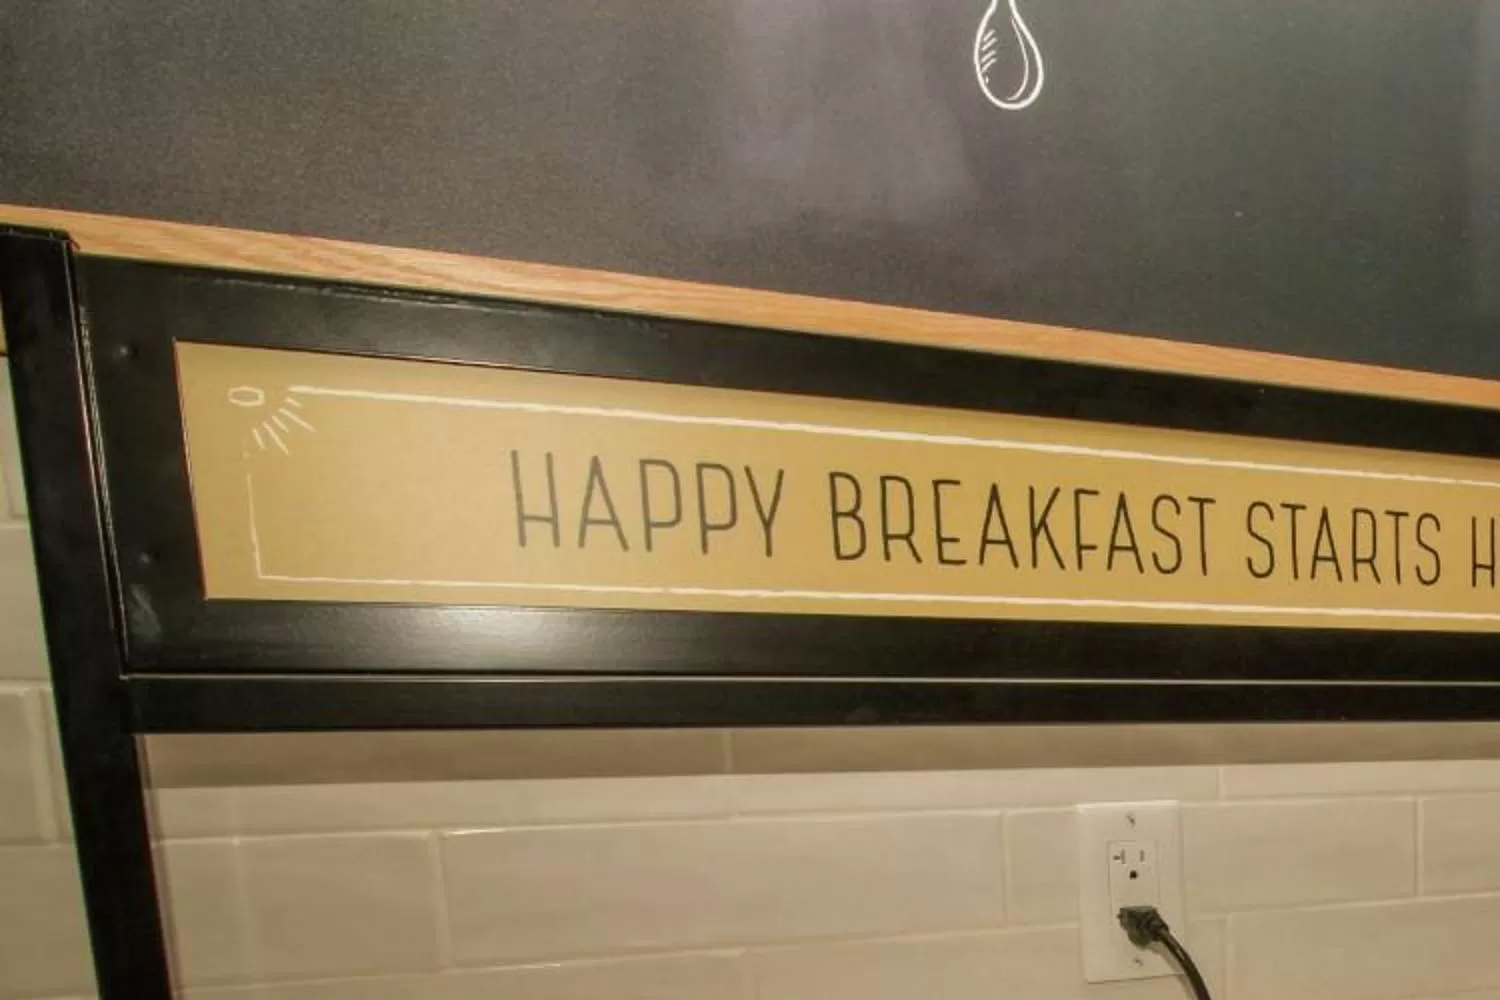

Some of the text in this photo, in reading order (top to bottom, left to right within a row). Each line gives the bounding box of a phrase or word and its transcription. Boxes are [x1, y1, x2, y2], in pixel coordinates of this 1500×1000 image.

[510, 449, 785, 558] HAPPY
[828, 470, 1217, 577] BREAKFAST
[1245, 500, 1443, 587] STARTS
